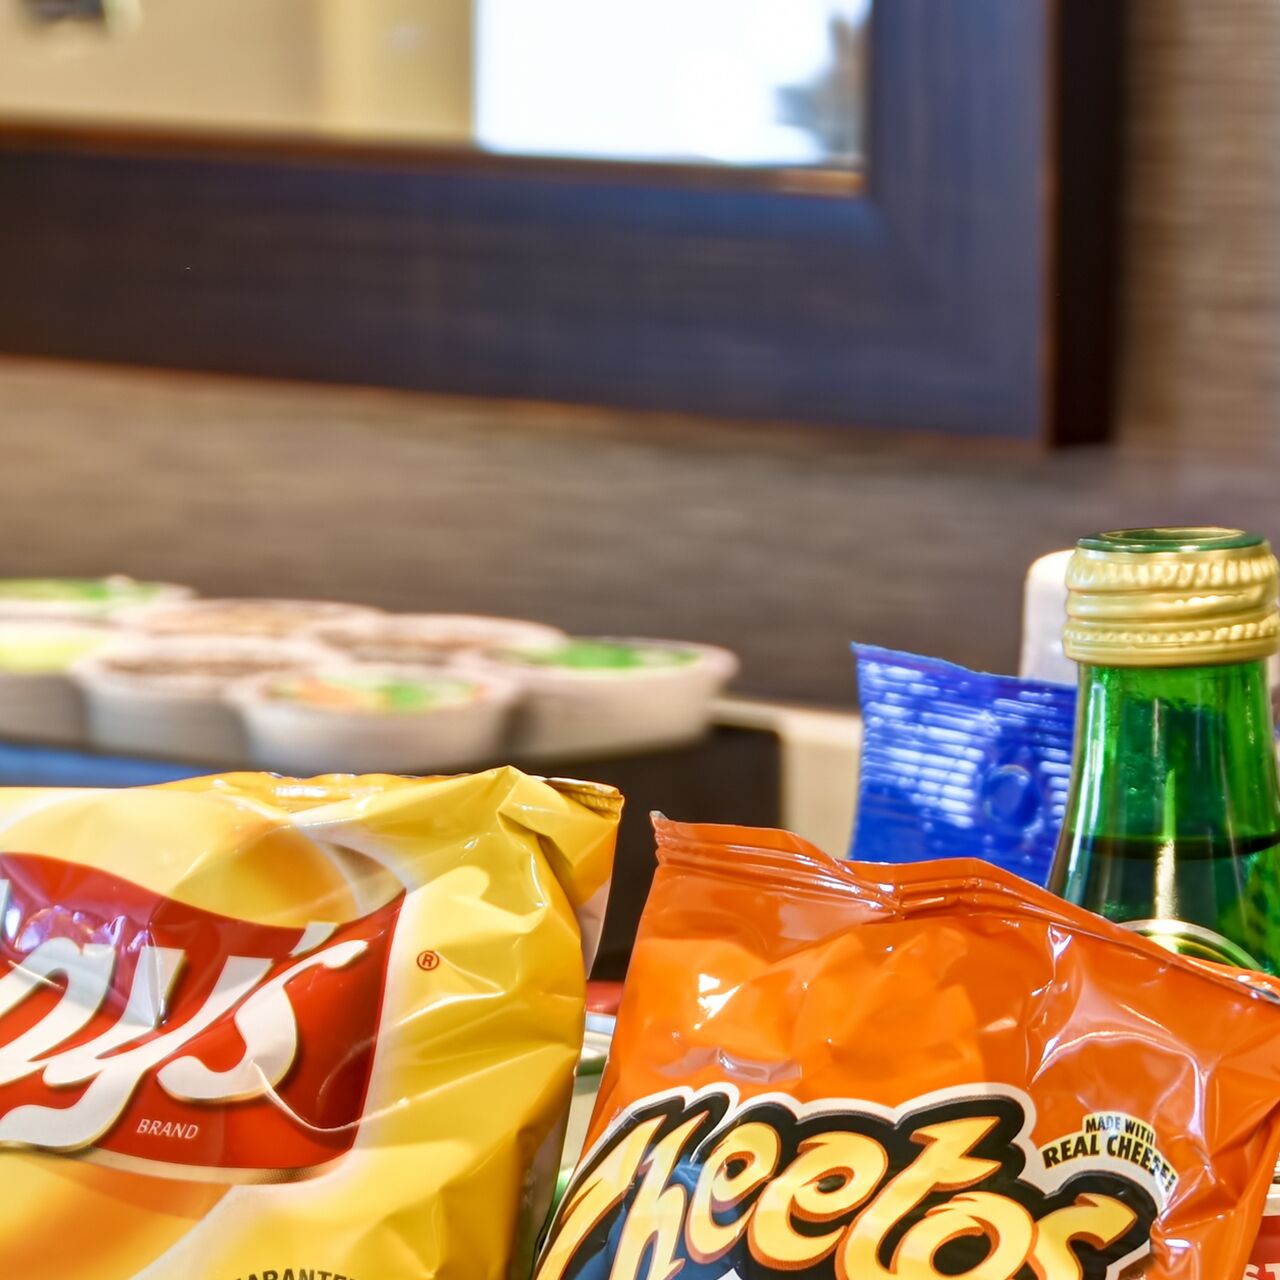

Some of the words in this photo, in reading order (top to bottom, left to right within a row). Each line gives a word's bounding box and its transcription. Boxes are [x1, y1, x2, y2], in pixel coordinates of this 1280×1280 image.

[136, 1118, 199, 1139] BRAND
[1086, 1115, 1121, 1134] MADE
[1125, 1118, 1155, 1143] WITH
[1042, 1134, 1100, 1170] REAL
